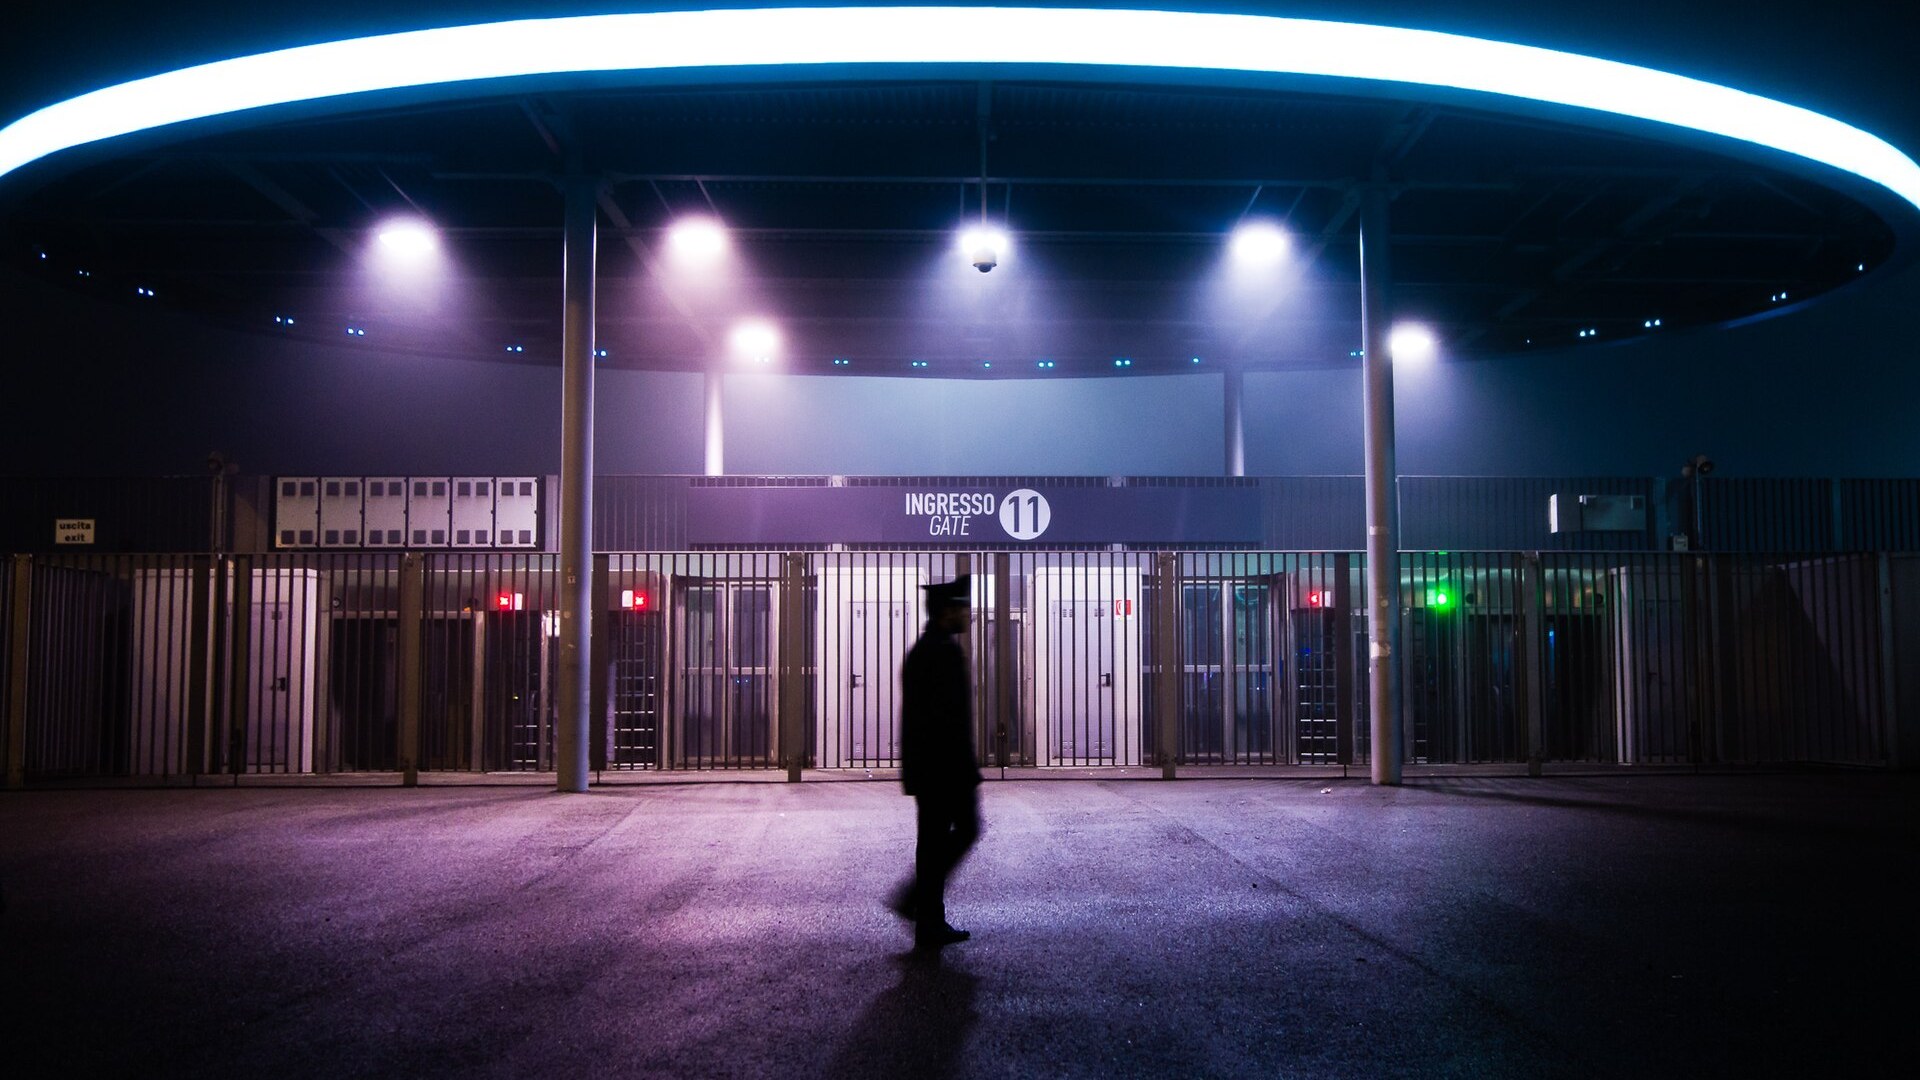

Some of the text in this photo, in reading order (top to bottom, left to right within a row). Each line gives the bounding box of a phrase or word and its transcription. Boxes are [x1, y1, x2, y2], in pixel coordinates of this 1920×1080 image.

[905, 492, 995, 515] INGRESSO
[1008, 495, 1039, 533] 11
[59, 521, 91, 530] uscita
[929, 515, 971, 536] GATE
[64, 533, 85, 542] exit
